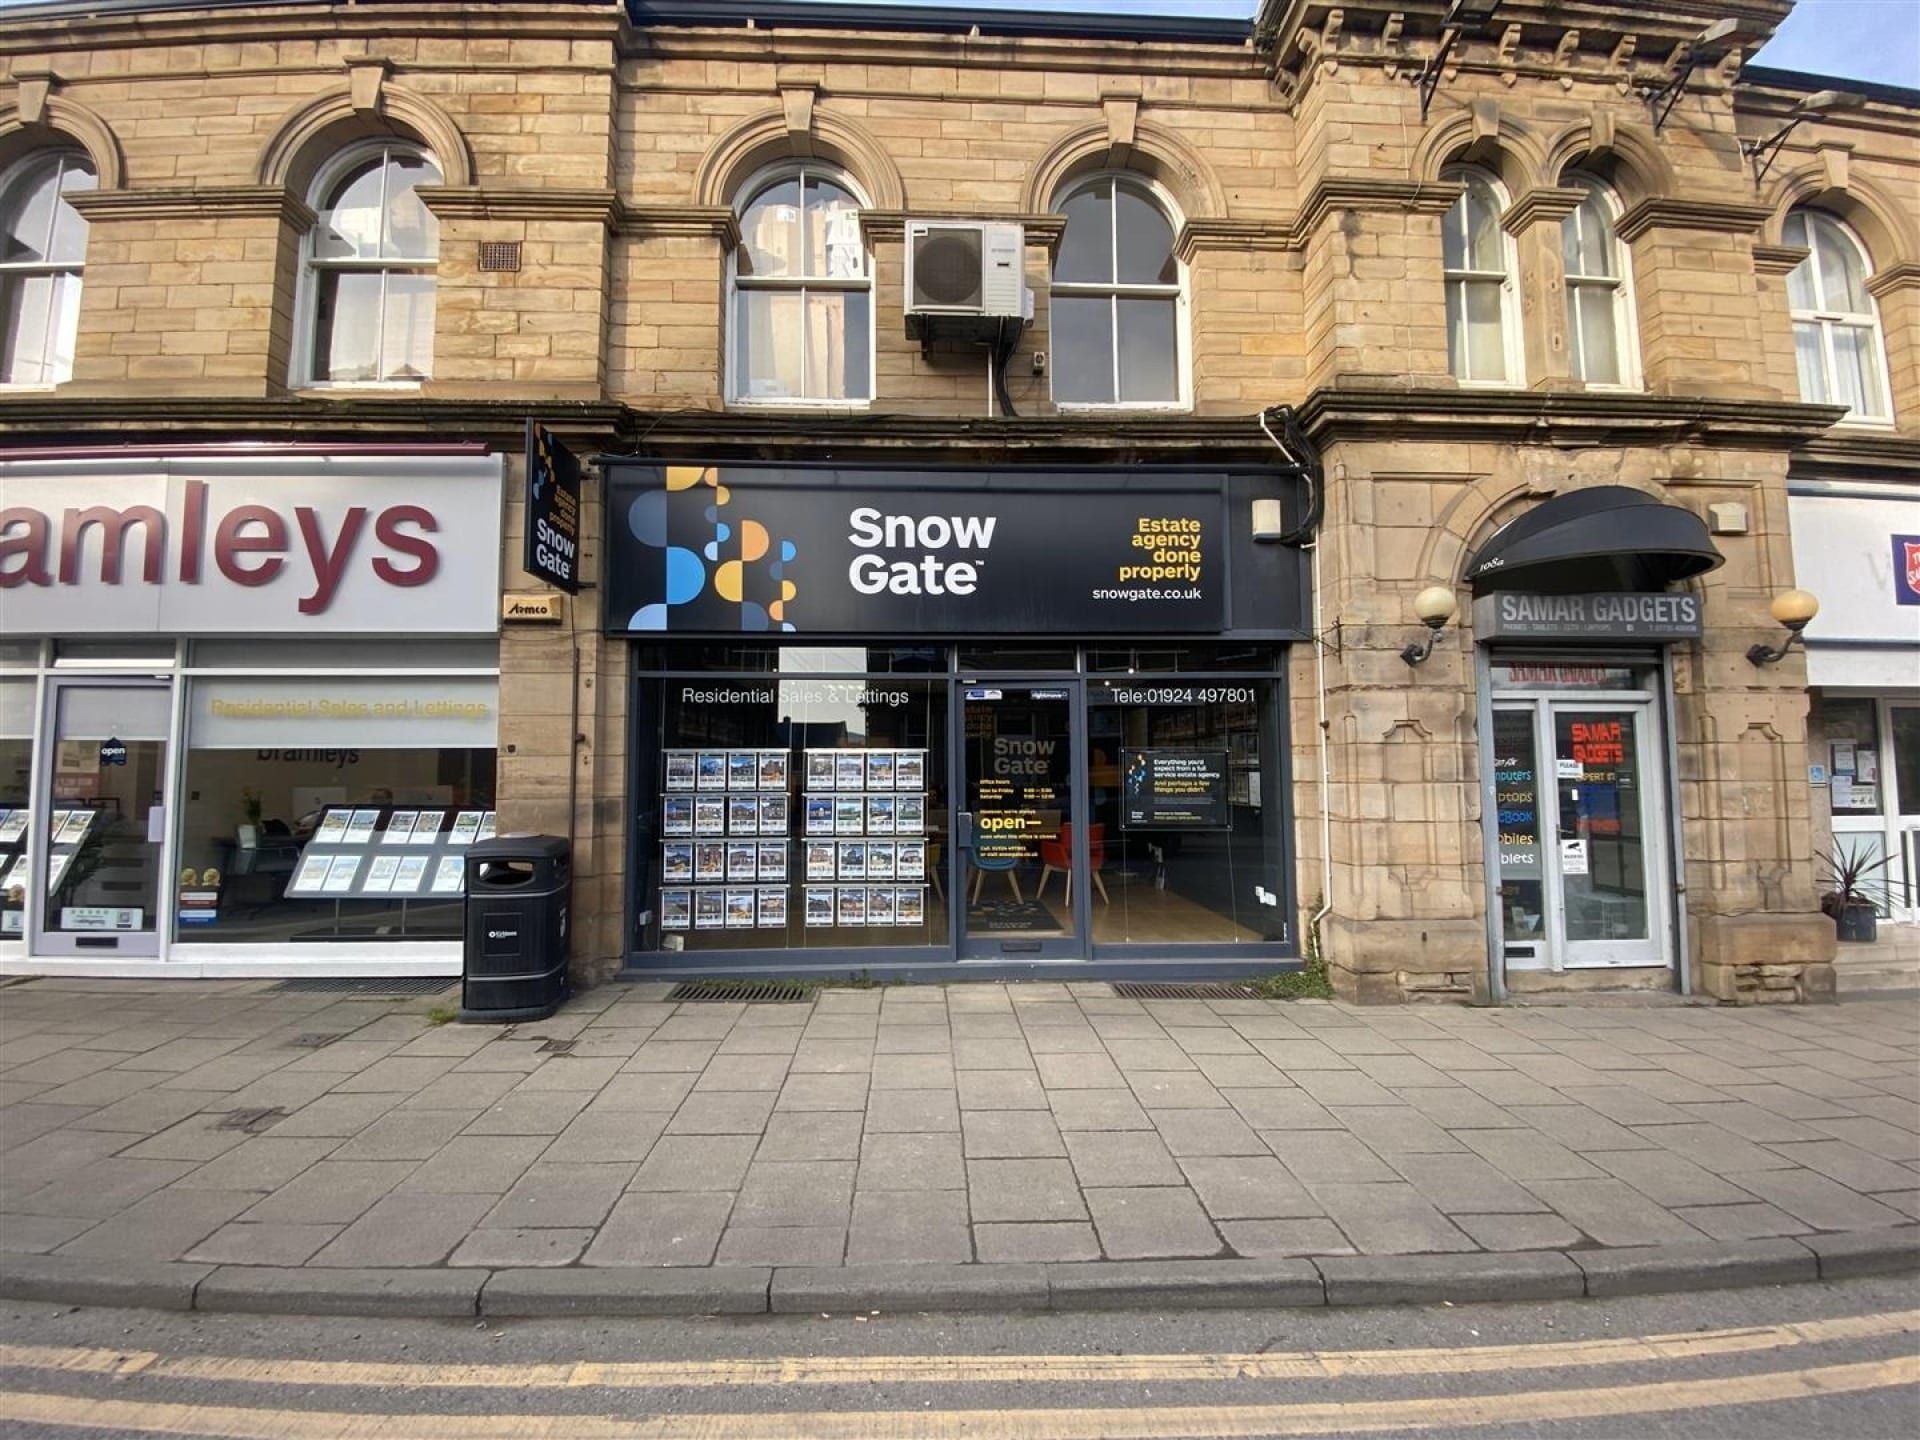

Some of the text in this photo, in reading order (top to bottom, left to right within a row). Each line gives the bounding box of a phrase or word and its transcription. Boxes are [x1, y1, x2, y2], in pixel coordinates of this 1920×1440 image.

[848, 507, 997, 549] Snow
[1138, 518, 1201, 533] Estate
[0, 477, 439, 615] amleys
[536, 517, 575, 559] Snow
[1132, 533, 1201, 550] agency
[536, 544, 570, 580] Gate
[1153, 549, 1201, 563] done
[1119, 564, 1201, 581] properly
[1092, 587, 1202, 601] snowgate.co.uk
[508, 603, 548, 615] Armco
[1503, 595, 1697, 623] SAMAR GADGETS
[682, 687, 909, 708] Residential Sales & Lettings
[1111, 687, 1256, 703] Tele:01924 497801
[211, 699, 489, 722] Residential Sales and Lettings
[101, 747, 126, 756] open
[994, 738, 1056, 756] Snow
[994, 757, 1049, 775] Gate
